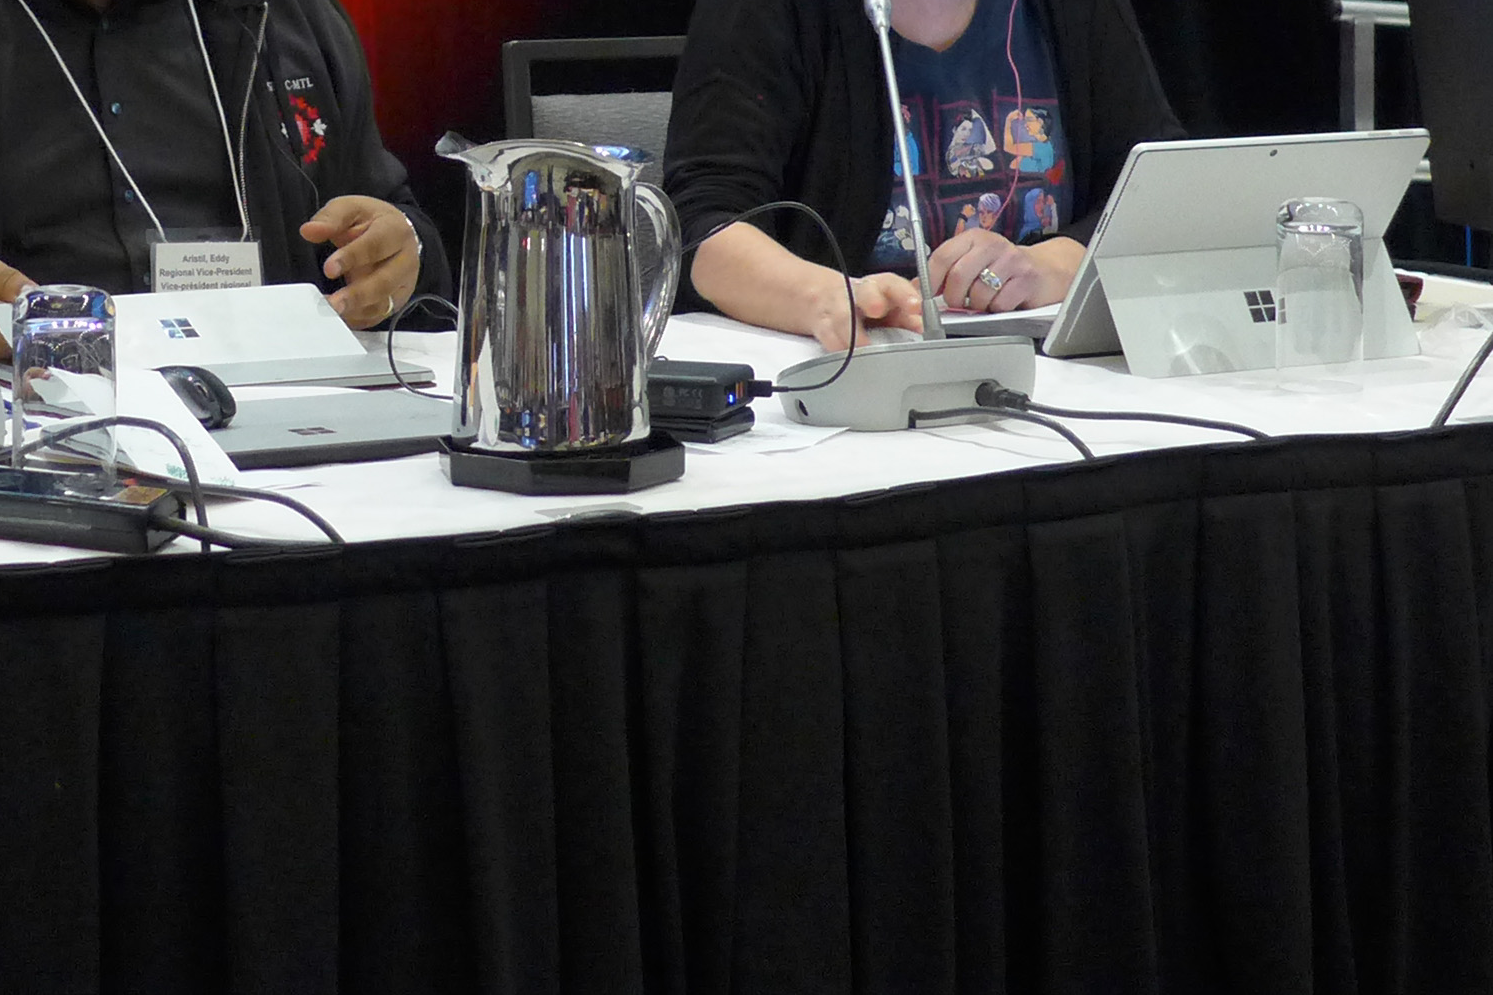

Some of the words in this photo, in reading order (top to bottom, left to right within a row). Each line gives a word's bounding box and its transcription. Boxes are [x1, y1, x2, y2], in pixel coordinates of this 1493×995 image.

[182, 254, 208, 264] Aristil,
[210, 254, 230, 264] Eddy
[159, 268, 195, 279] Regional
[196, 267, 253, 276] Vice-President
